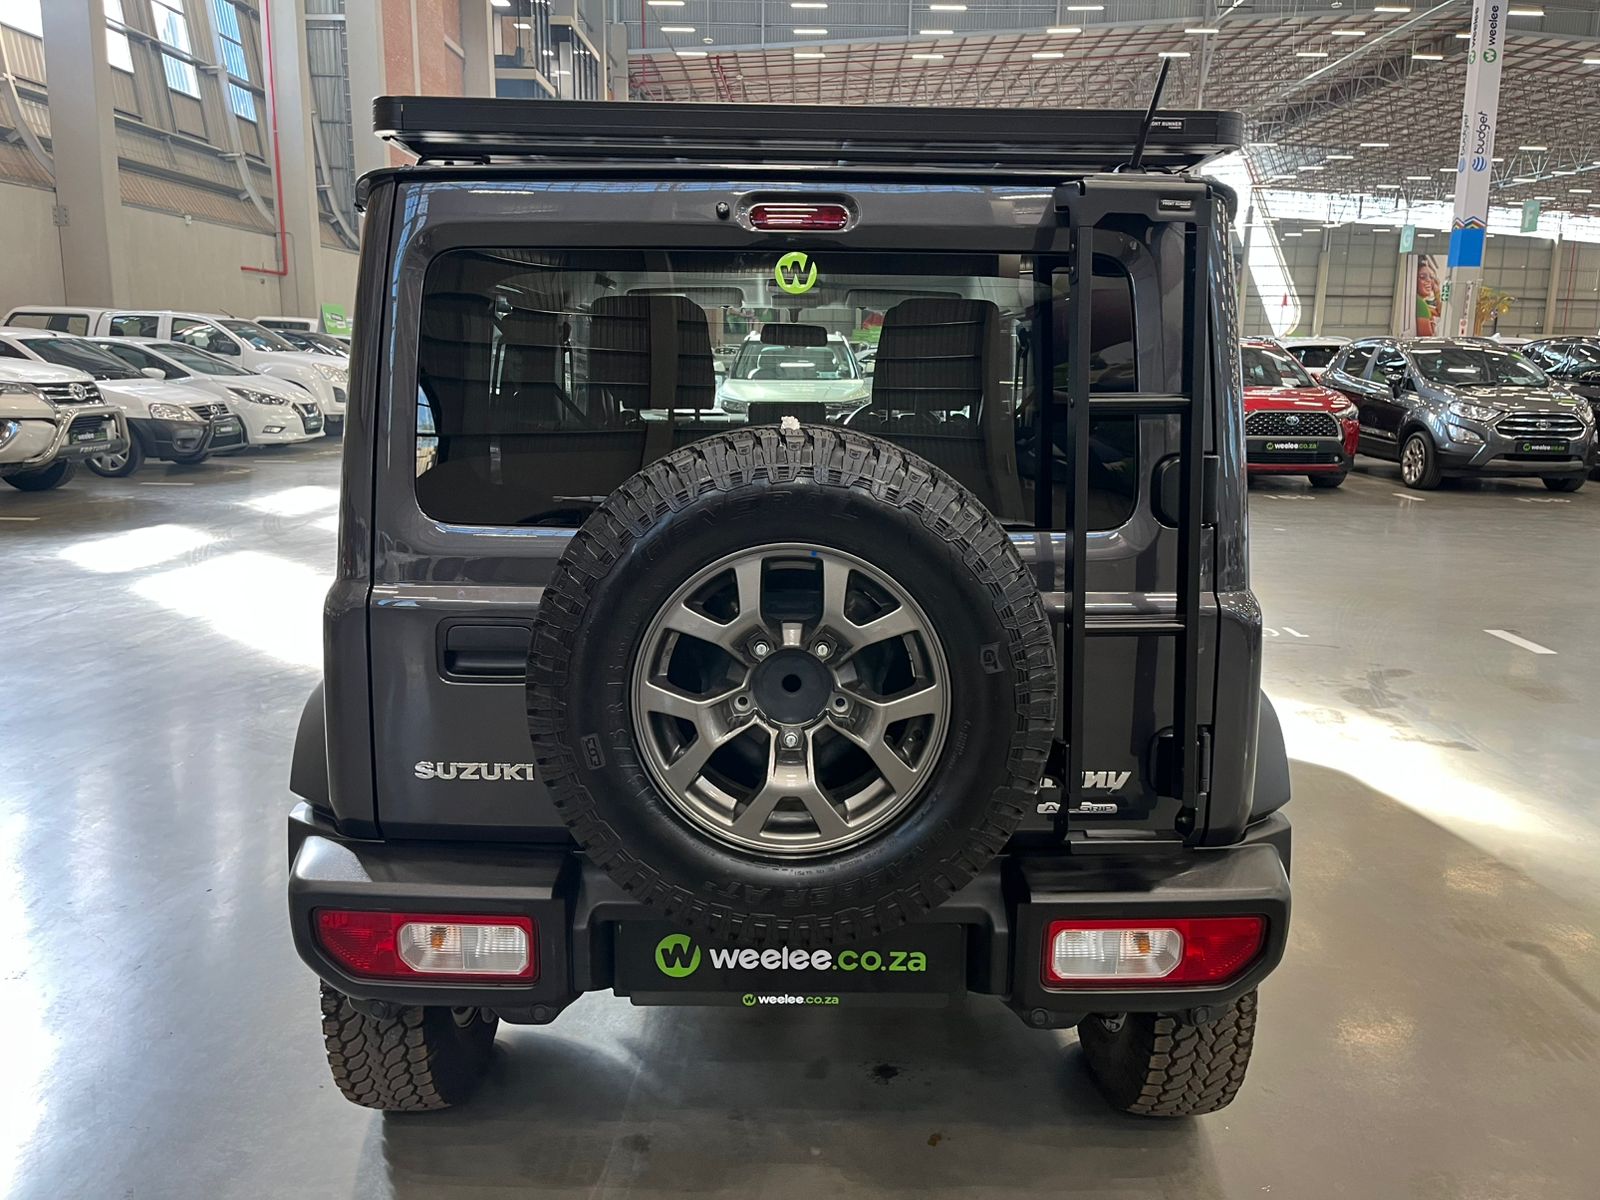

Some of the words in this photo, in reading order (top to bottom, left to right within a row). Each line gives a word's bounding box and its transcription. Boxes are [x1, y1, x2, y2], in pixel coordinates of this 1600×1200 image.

[1489, 5, 1499, 46] weelee
[1474, 111, 1491, 155] budget
[414, 760, 534, 781] SUZUKI
[709, 945, 927, 972] weelee.co.za
[757, 993, 840, 1005] weelee.co.za
